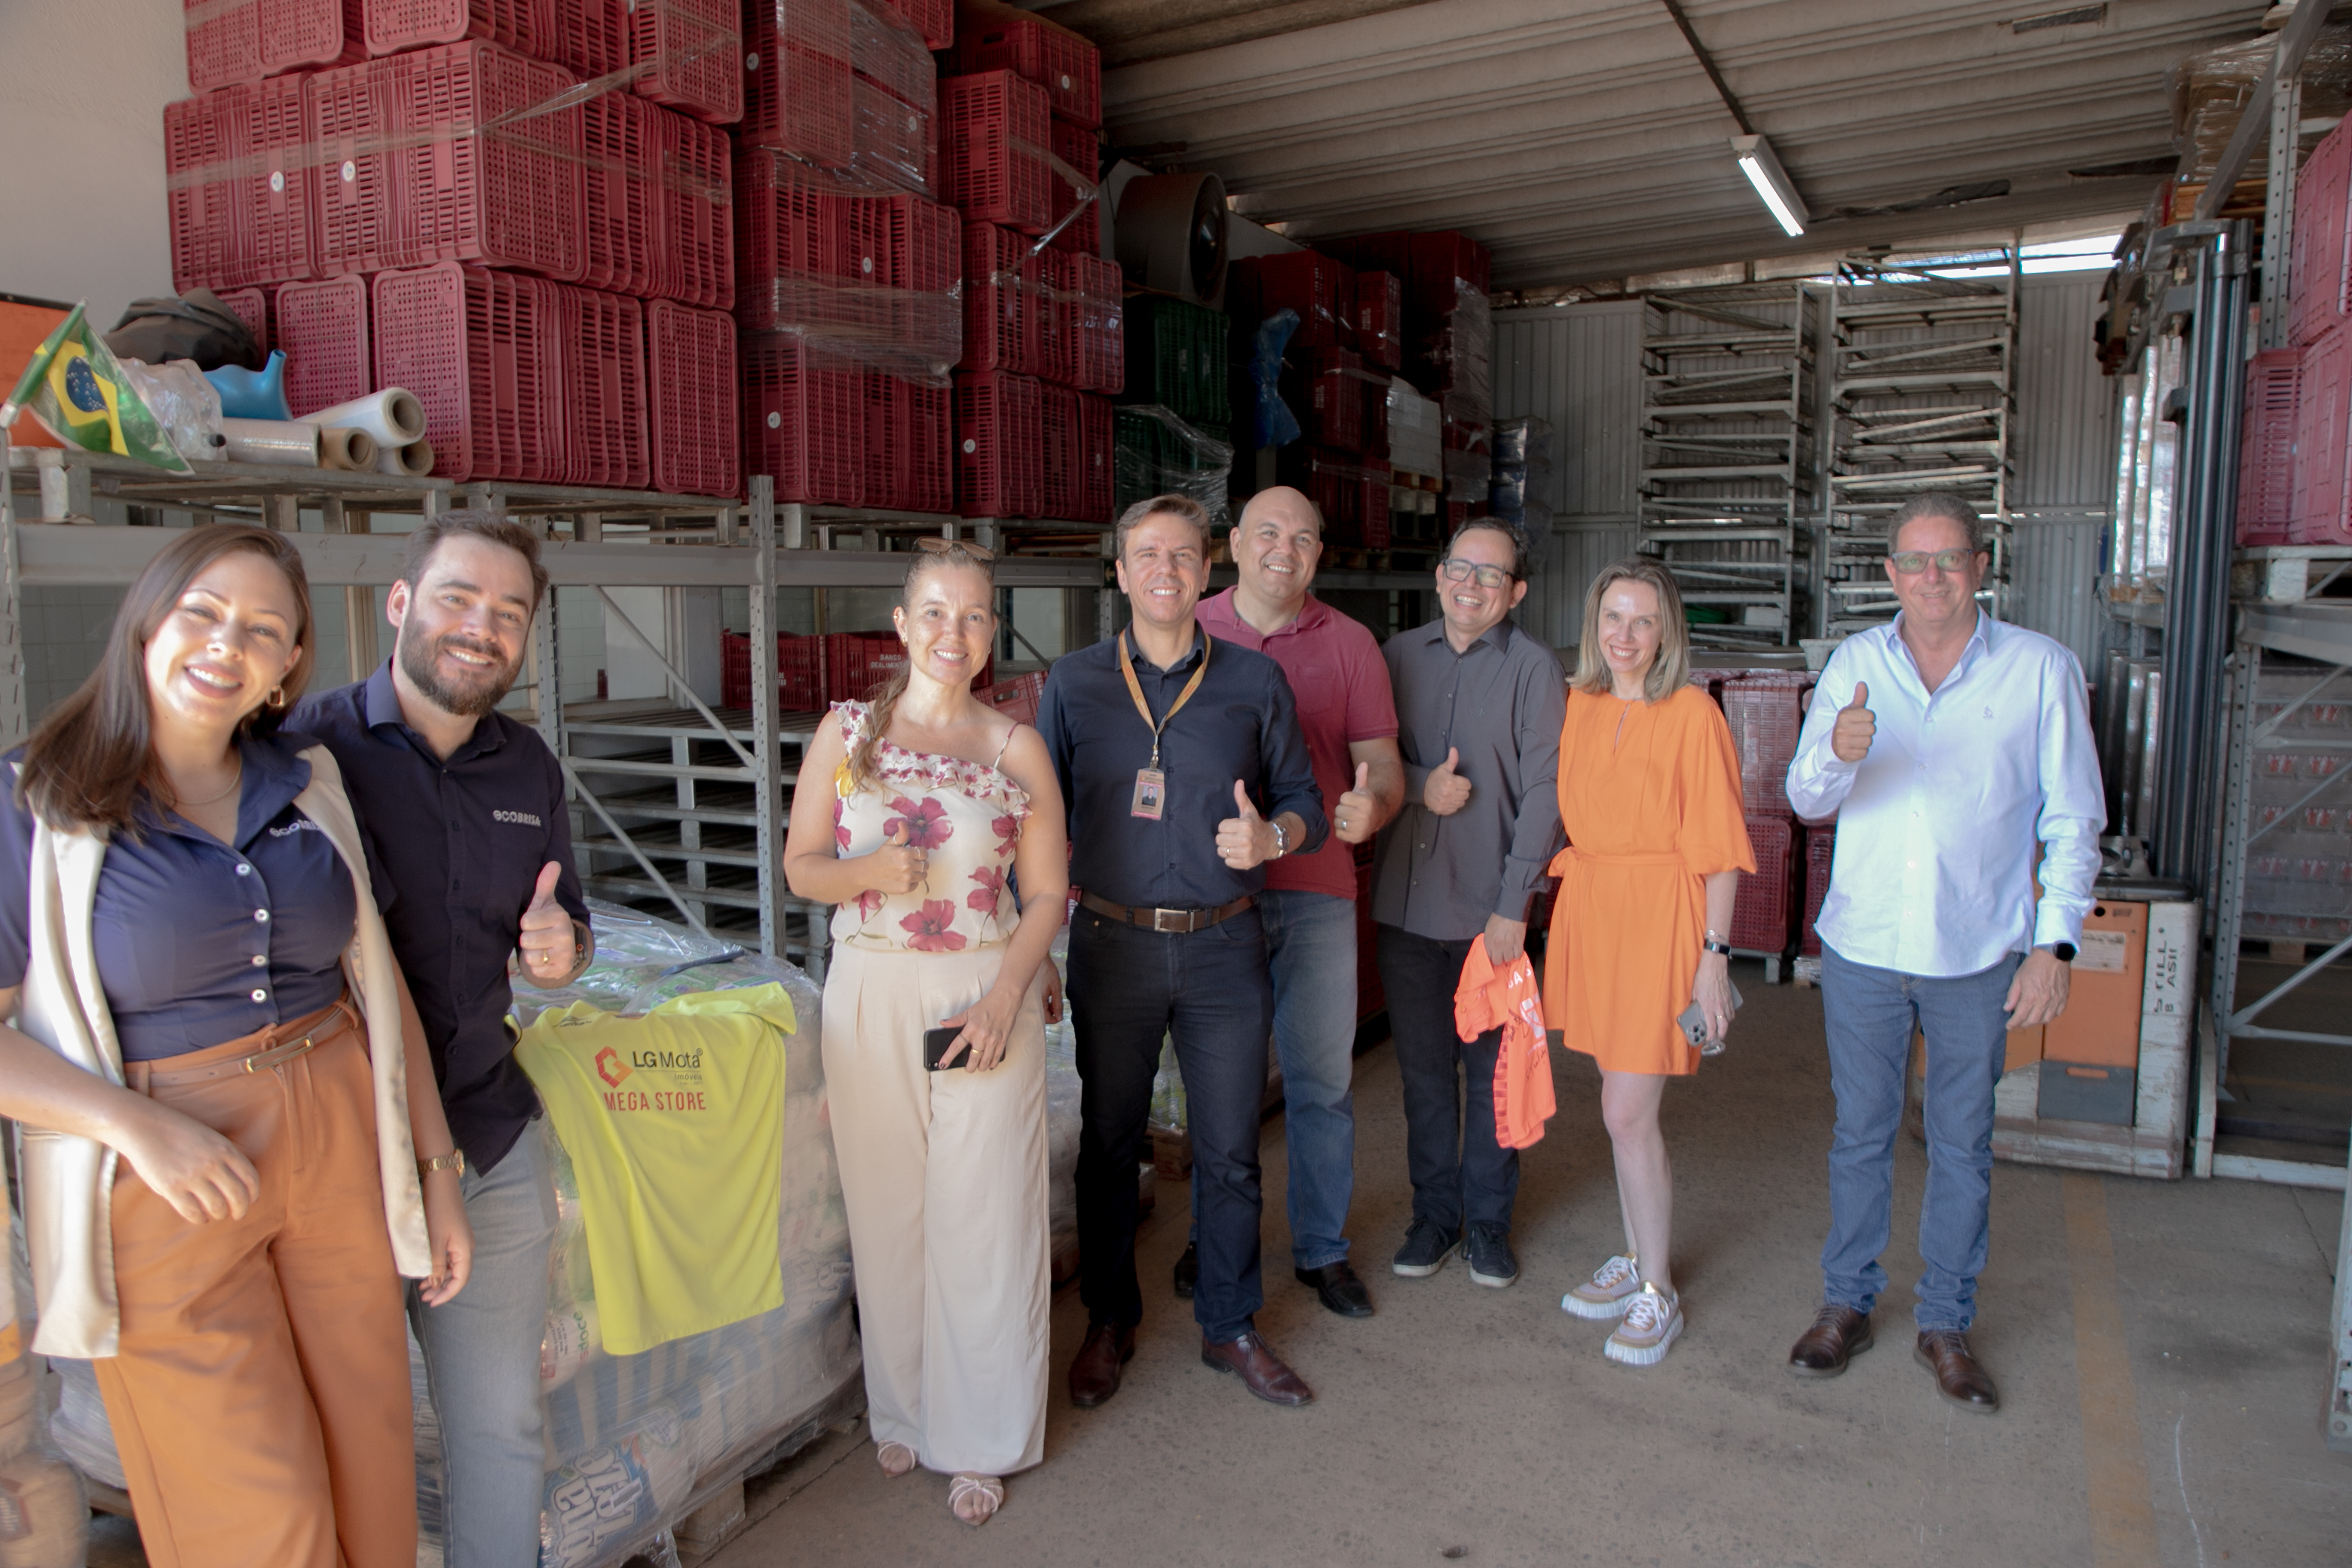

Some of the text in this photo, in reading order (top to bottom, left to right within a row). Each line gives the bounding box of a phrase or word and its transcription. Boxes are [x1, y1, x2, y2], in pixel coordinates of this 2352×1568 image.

[632, 1050, 657, 1067] LG
[603, 1092, 706, 1111] MEGA STORE
